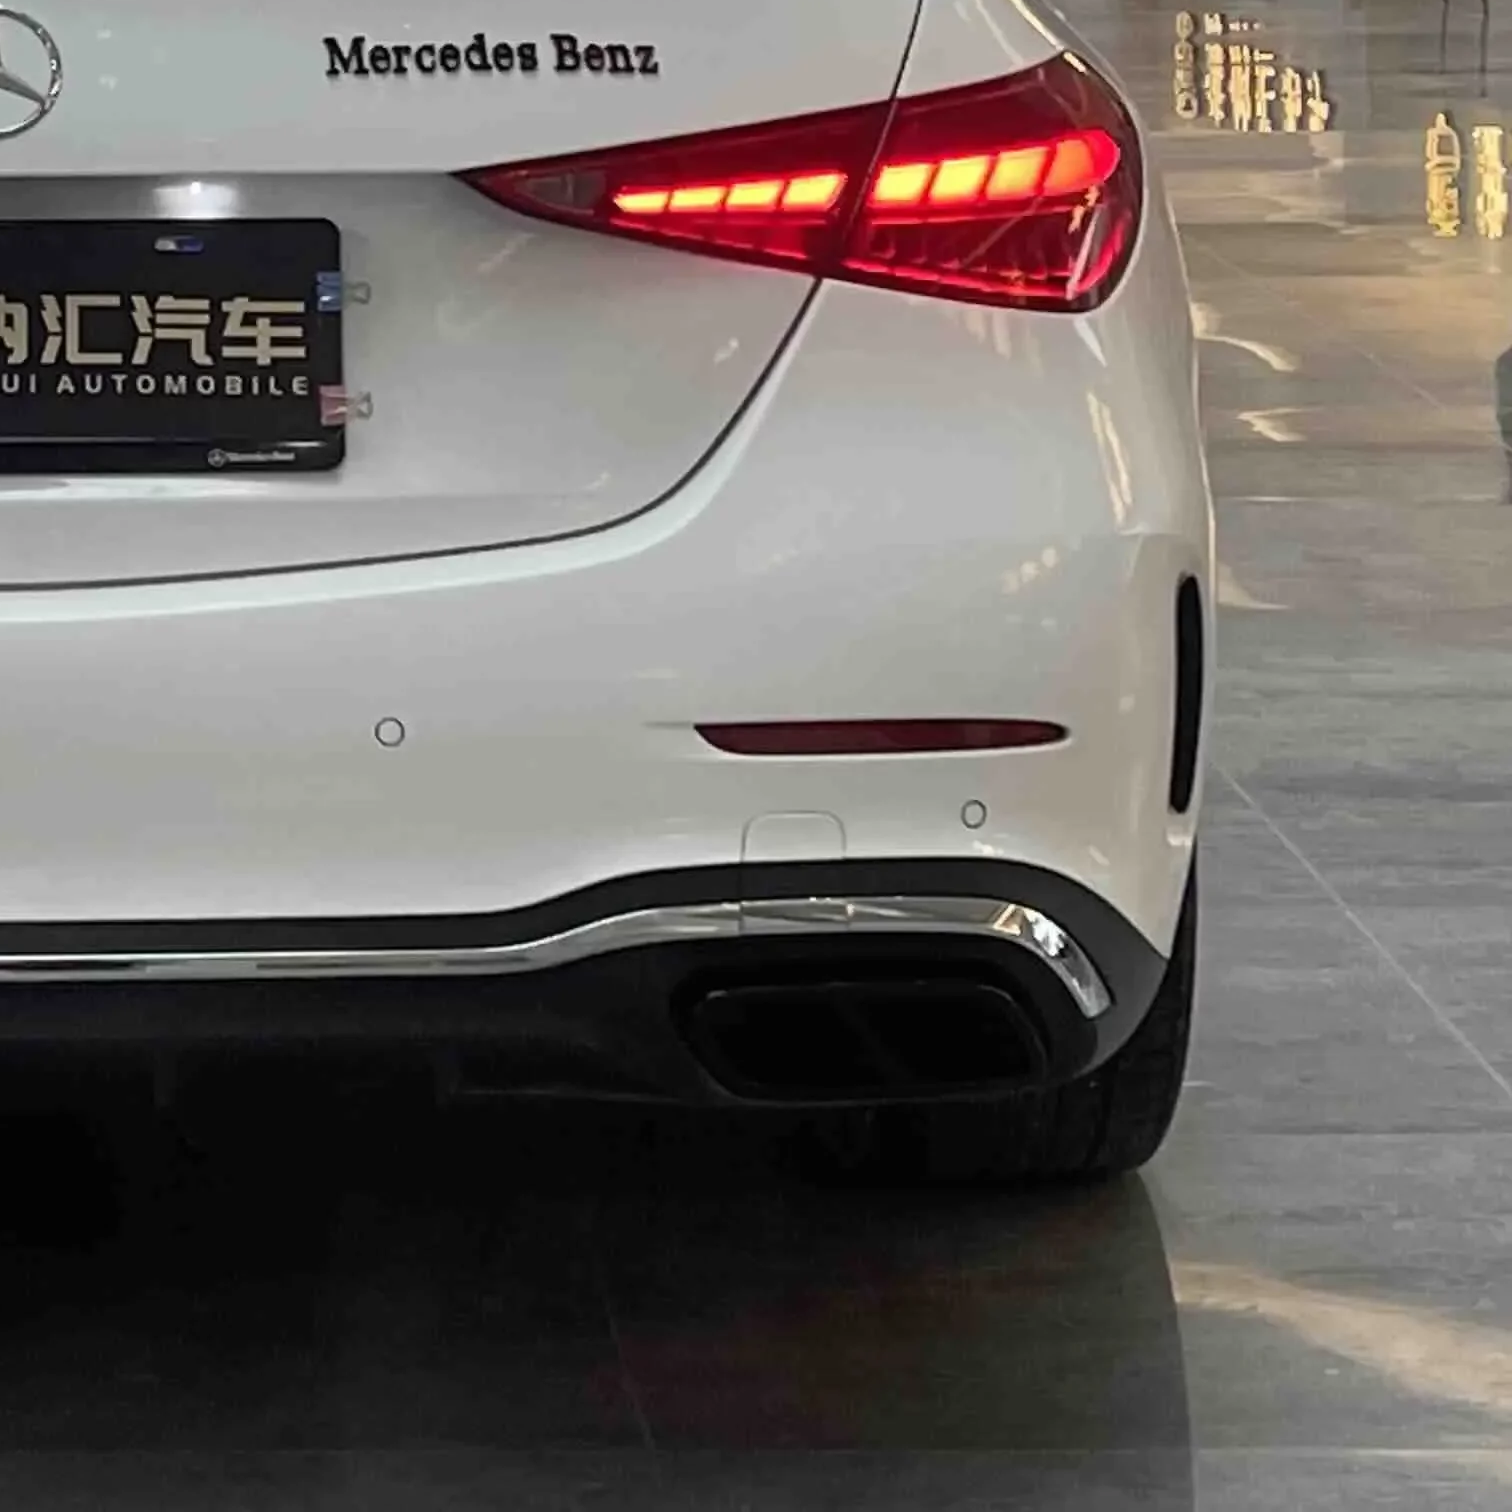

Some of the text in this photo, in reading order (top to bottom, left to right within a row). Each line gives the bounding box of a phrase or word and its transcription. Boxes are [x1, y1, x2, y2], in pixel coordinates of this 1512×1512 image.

[322, 33, 659, 75] Mercedes Benz
[56, 375, 310, 396] AUTOMOBILE
